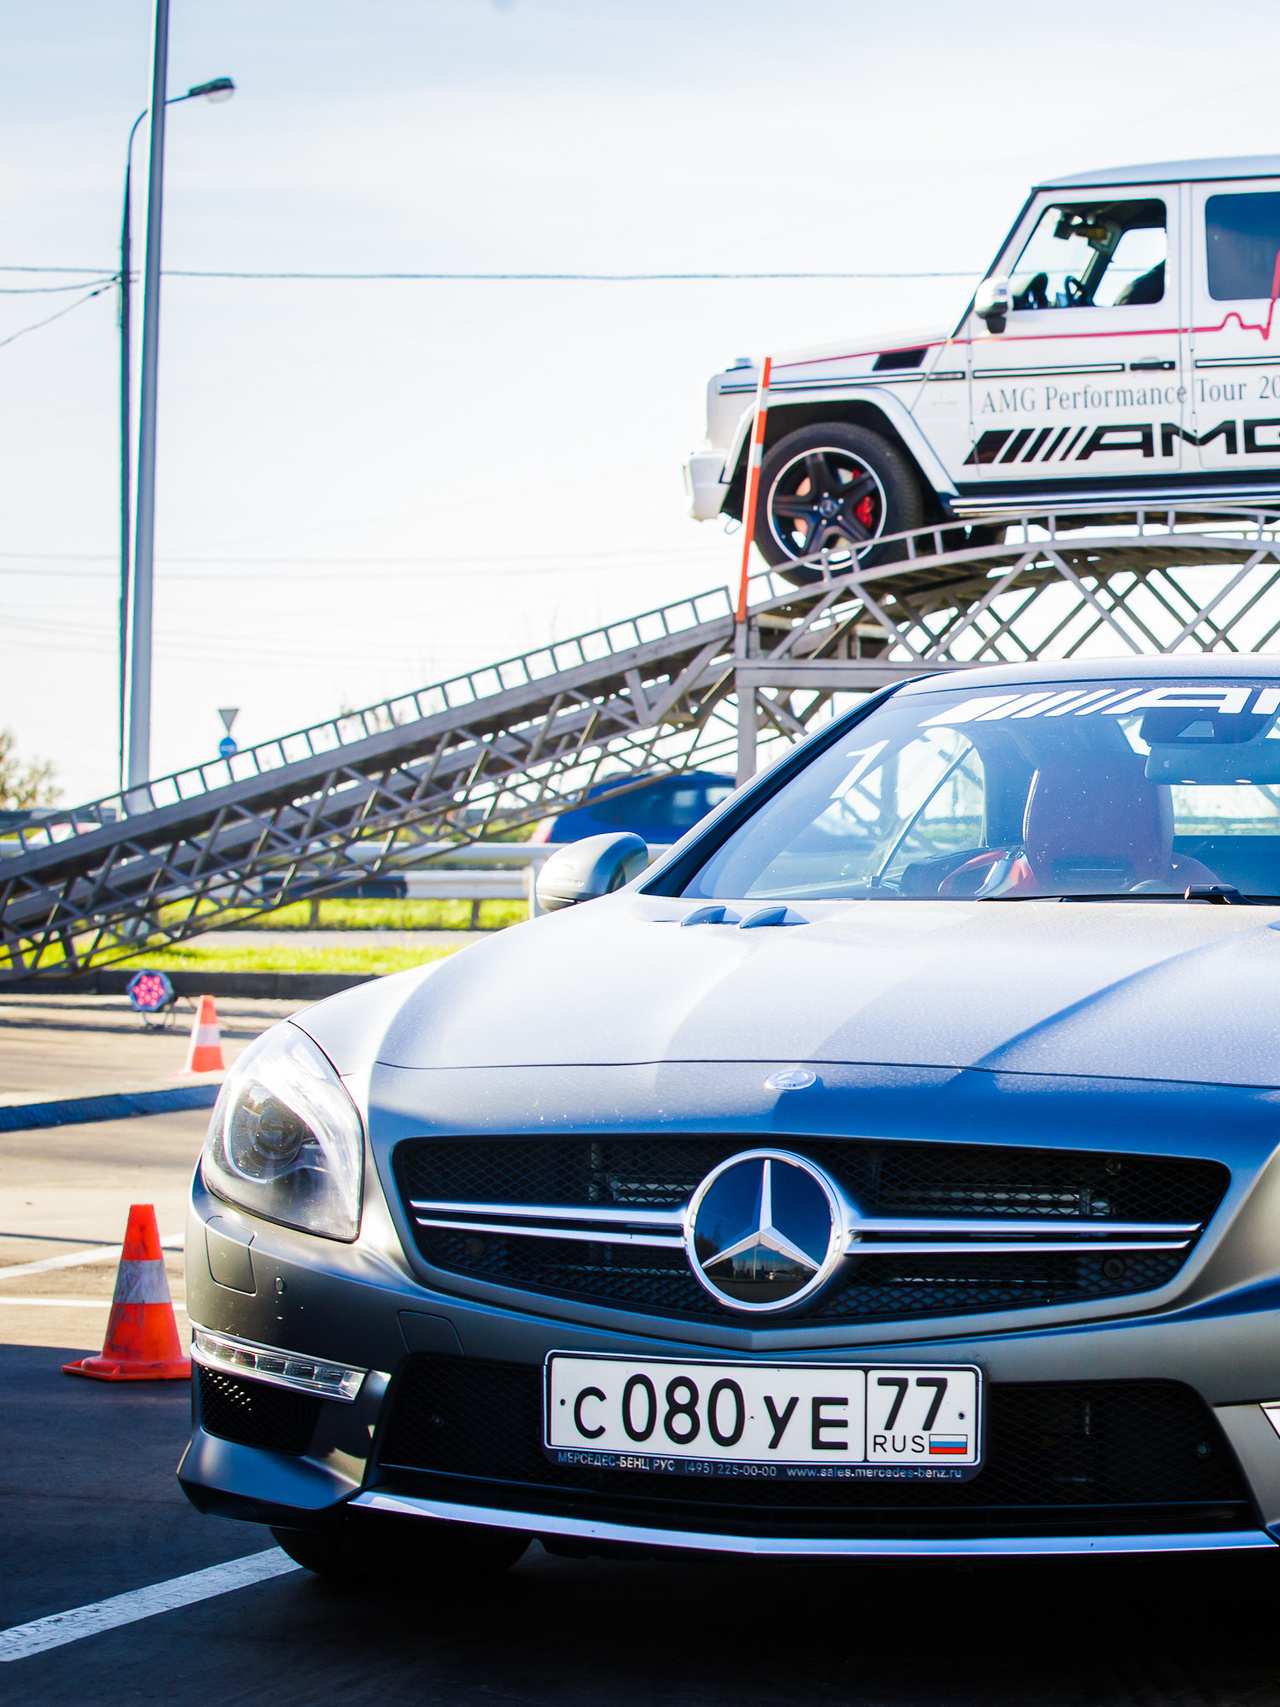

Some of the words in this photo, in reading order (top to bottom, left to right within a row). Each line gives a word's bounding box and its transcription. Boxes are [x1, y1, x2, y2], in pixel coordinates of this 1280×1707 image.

[981, 388, 1037, 414] AMG
[1045, 385, 1188, 410] Performance
[1195, 377, 1247, 402] Tour
[876, 1377, 948, 1431] 77
[873, 1434, 925, 1453] RUS
[558, 1451, 649, 1470] МЕРСЕДЕС-БЕНЦ
[653, 1459, 675, 1471] РУС
[684, 1460, 713, 1475] (495)
[717, 1464, 777, 1477] 225-00-00
[786, 1467, 962, 1479] www.sales.mercedes-benz.ru
